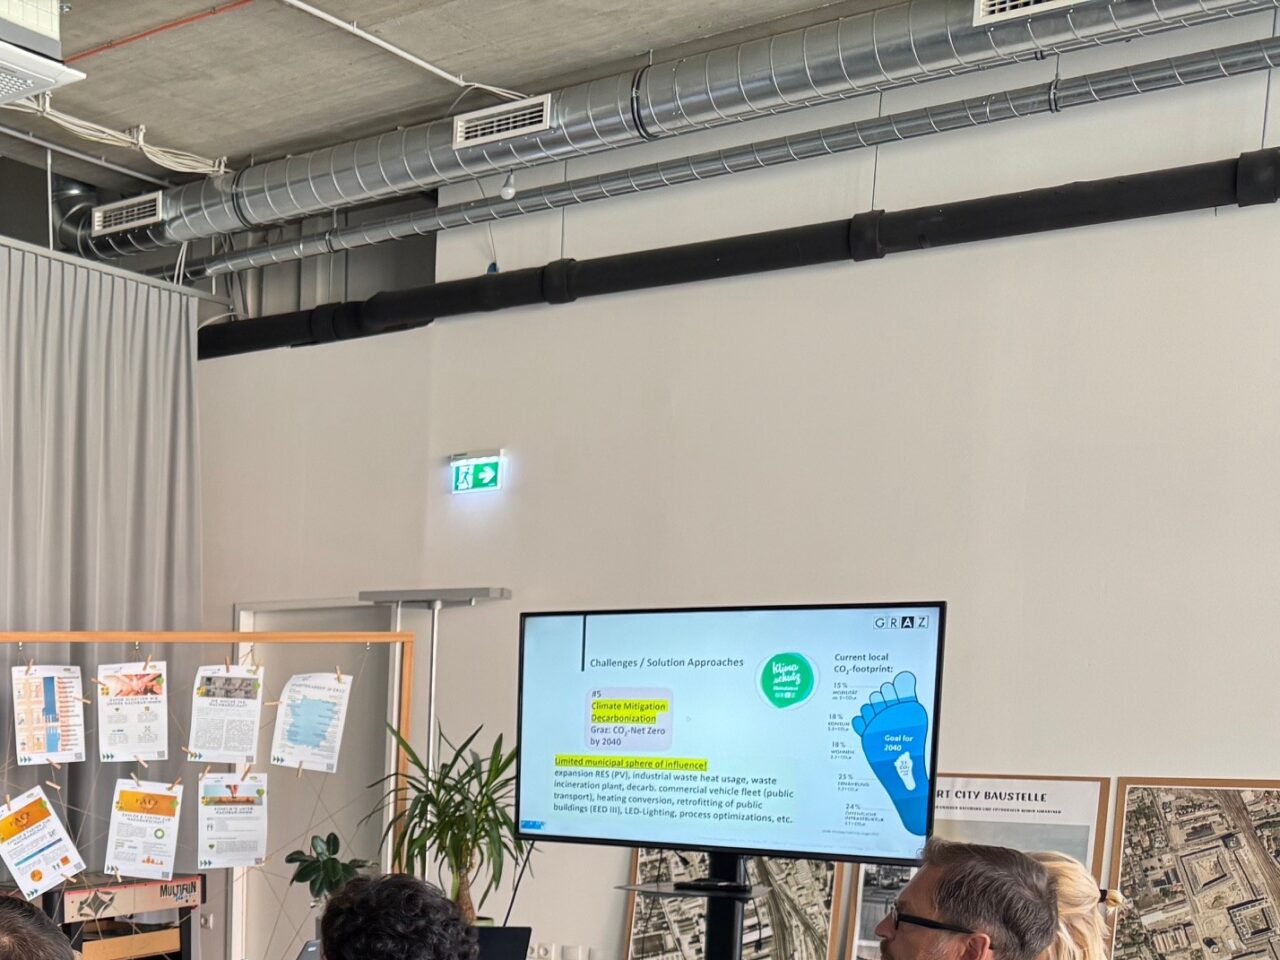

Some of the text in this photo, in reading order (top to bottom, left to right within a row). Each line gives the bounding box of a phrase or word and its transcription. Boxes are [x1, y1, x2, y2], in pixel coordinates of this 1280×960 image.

[874, 616, 928, 629] GRAZ
[590, 658, 638, 669] Challenges
[646, 657, 685, 668] Solution
[687, 657, 744, 669] Approaches
[834, 652, 889, 662] Current local
[591, 701, 666, 712] Climate Mitigation
[591, 713, 657, 724] Decarbonization
[590, 726, 611, 736] Graz:
[647, 727, 666, 736] Zero
[590, 737, 622, 747] by 2040
[884, 734, 914, 743] Goal for
[884, 744, 902, 752] 2040
[555, 757, 707, 771] Limited municipal sphere of influence!
[554, 770, 593, 780] expansion
[595, 770, 610, 778] RES
[632, 771, 672, 781] industrial
[673, 774, 698, 782] waste
[700, 773, 719, 783] heat
[721, 775, 749, 785] usage,
[751, 776, 777, 785] waste
[553, 780, 795, 799] incineration plant, decarb. commercial vehicle fleet (public
[553, 792, 763, 811] transport), heating conversion, retrofitting of public
[954, 790, 981, 800] CITY
[984, 791, 1048, 803] BAUSTELLE
[553, 803, 588, 814] buildings
[624, 807, 678, 819] LED-Lighting,
[679, 811, 711, 821] process
[713, 812, 775, 824] optimizations,
[776, 815, 793, 824] etc.
